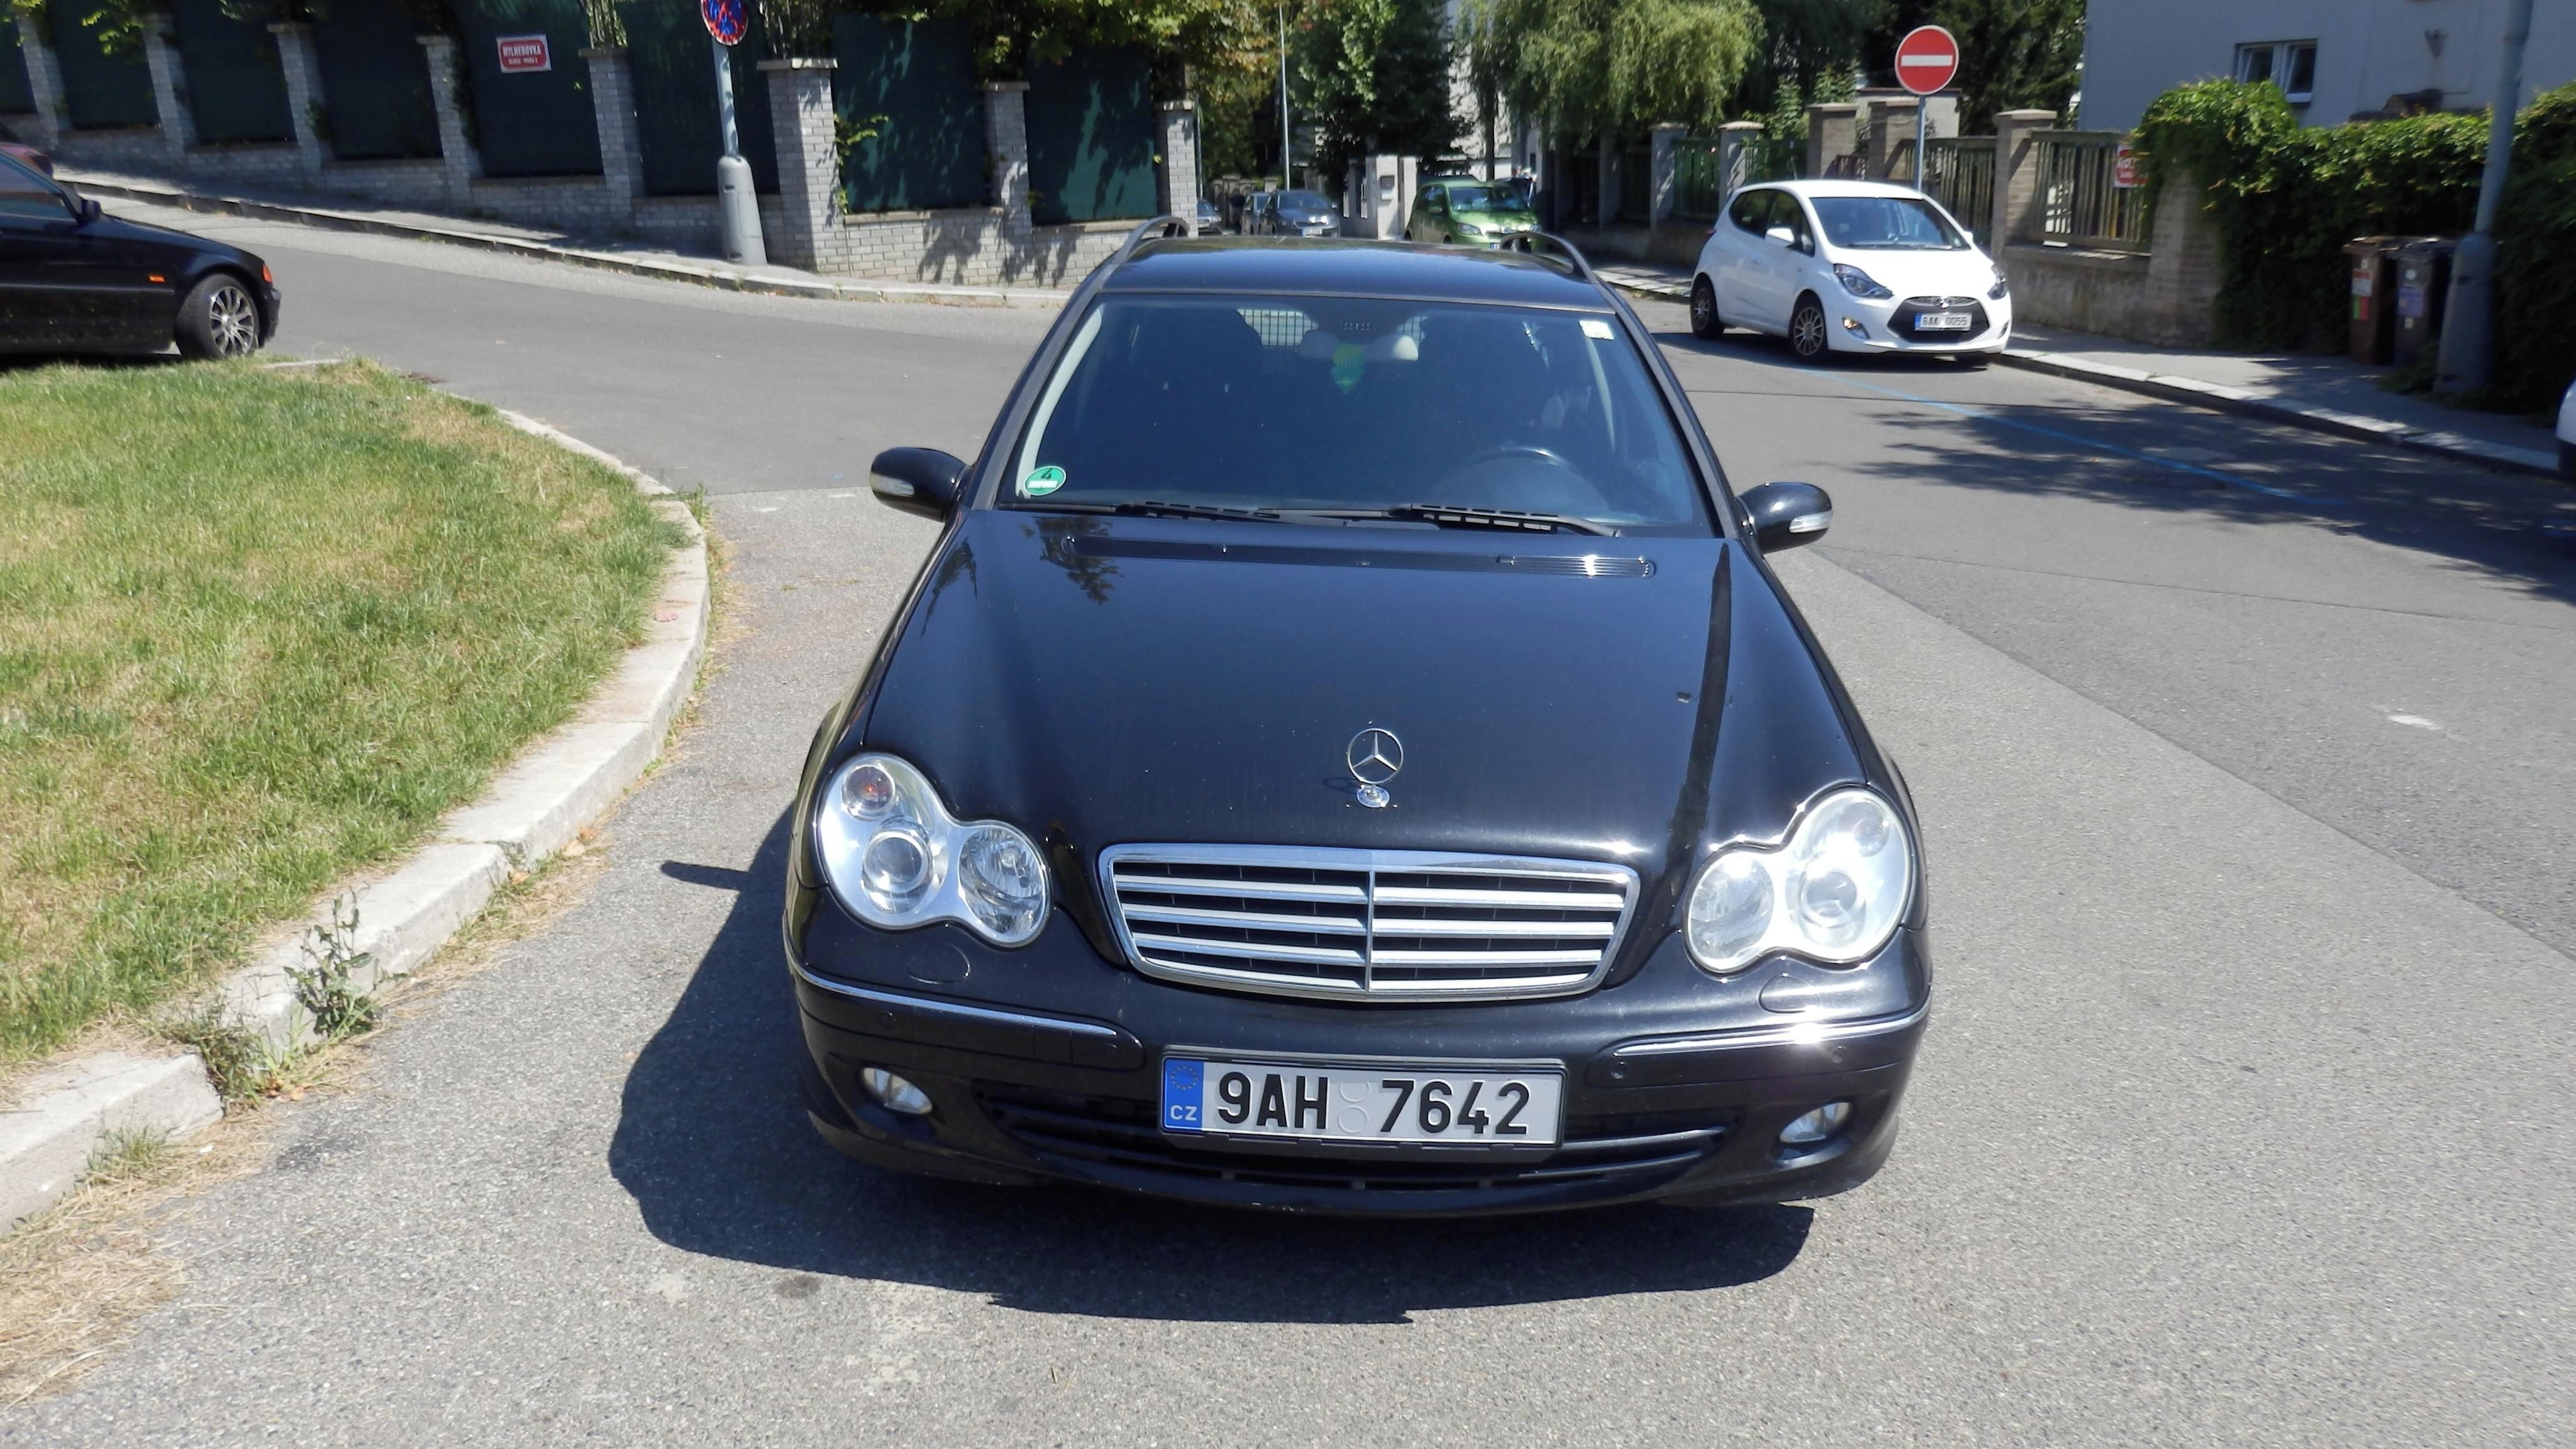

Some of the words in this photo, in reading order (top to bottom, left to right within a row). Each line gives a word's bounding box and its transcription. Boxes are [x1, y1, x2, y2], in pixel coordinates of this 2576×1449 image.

[1041, 468, 1052, 480] 4
[1217, 1071, 1328, 1130] 9AH
[1380, 1079, 1530, 1135] 7642
[1170, 1104, 1197, 1122] CZ
